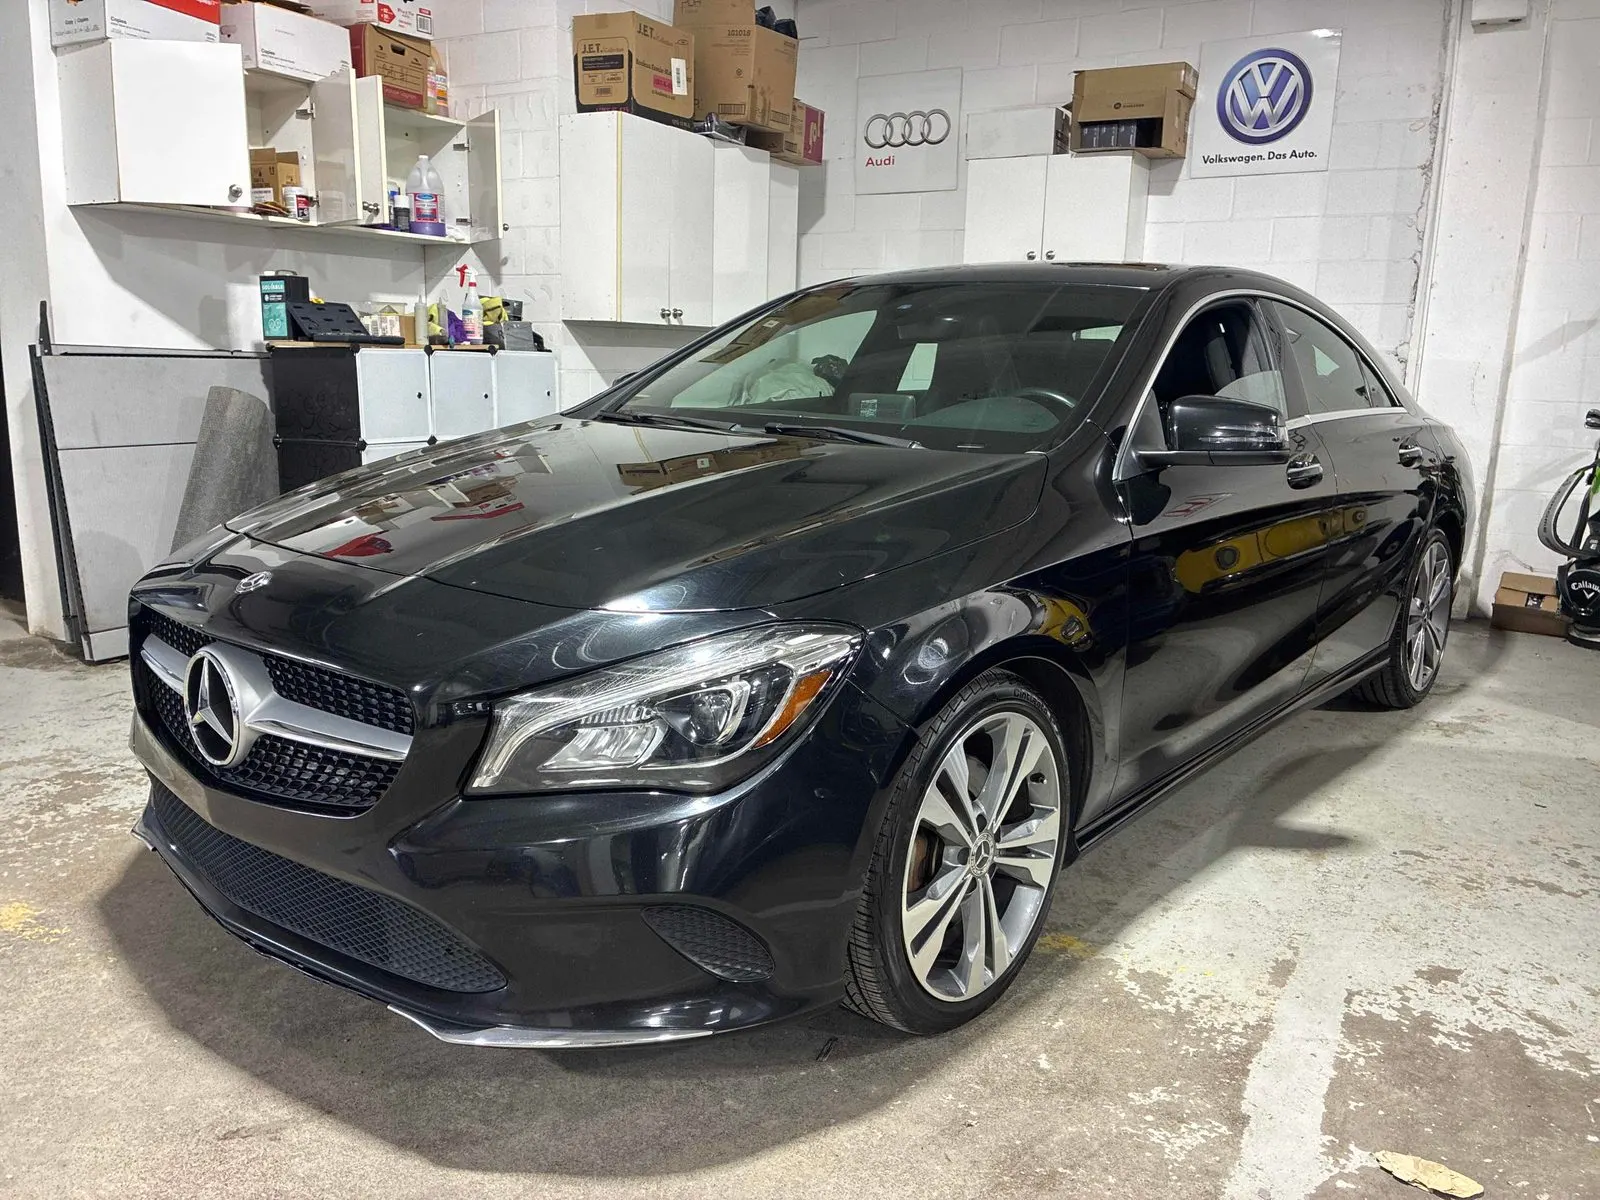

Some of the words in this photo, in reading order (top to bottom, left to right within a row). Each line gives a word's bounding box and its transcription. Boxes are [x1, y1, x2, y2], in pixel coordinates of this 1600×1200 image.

[865, 155, 895, 168] Audi
[1202, 154, 1266, 164] Volkswagen.
[1267, 151, 1287, 160] Das
[1289, 149, 1318, 159] Auto.
[1570, 580, 1600, 593] Callaw
